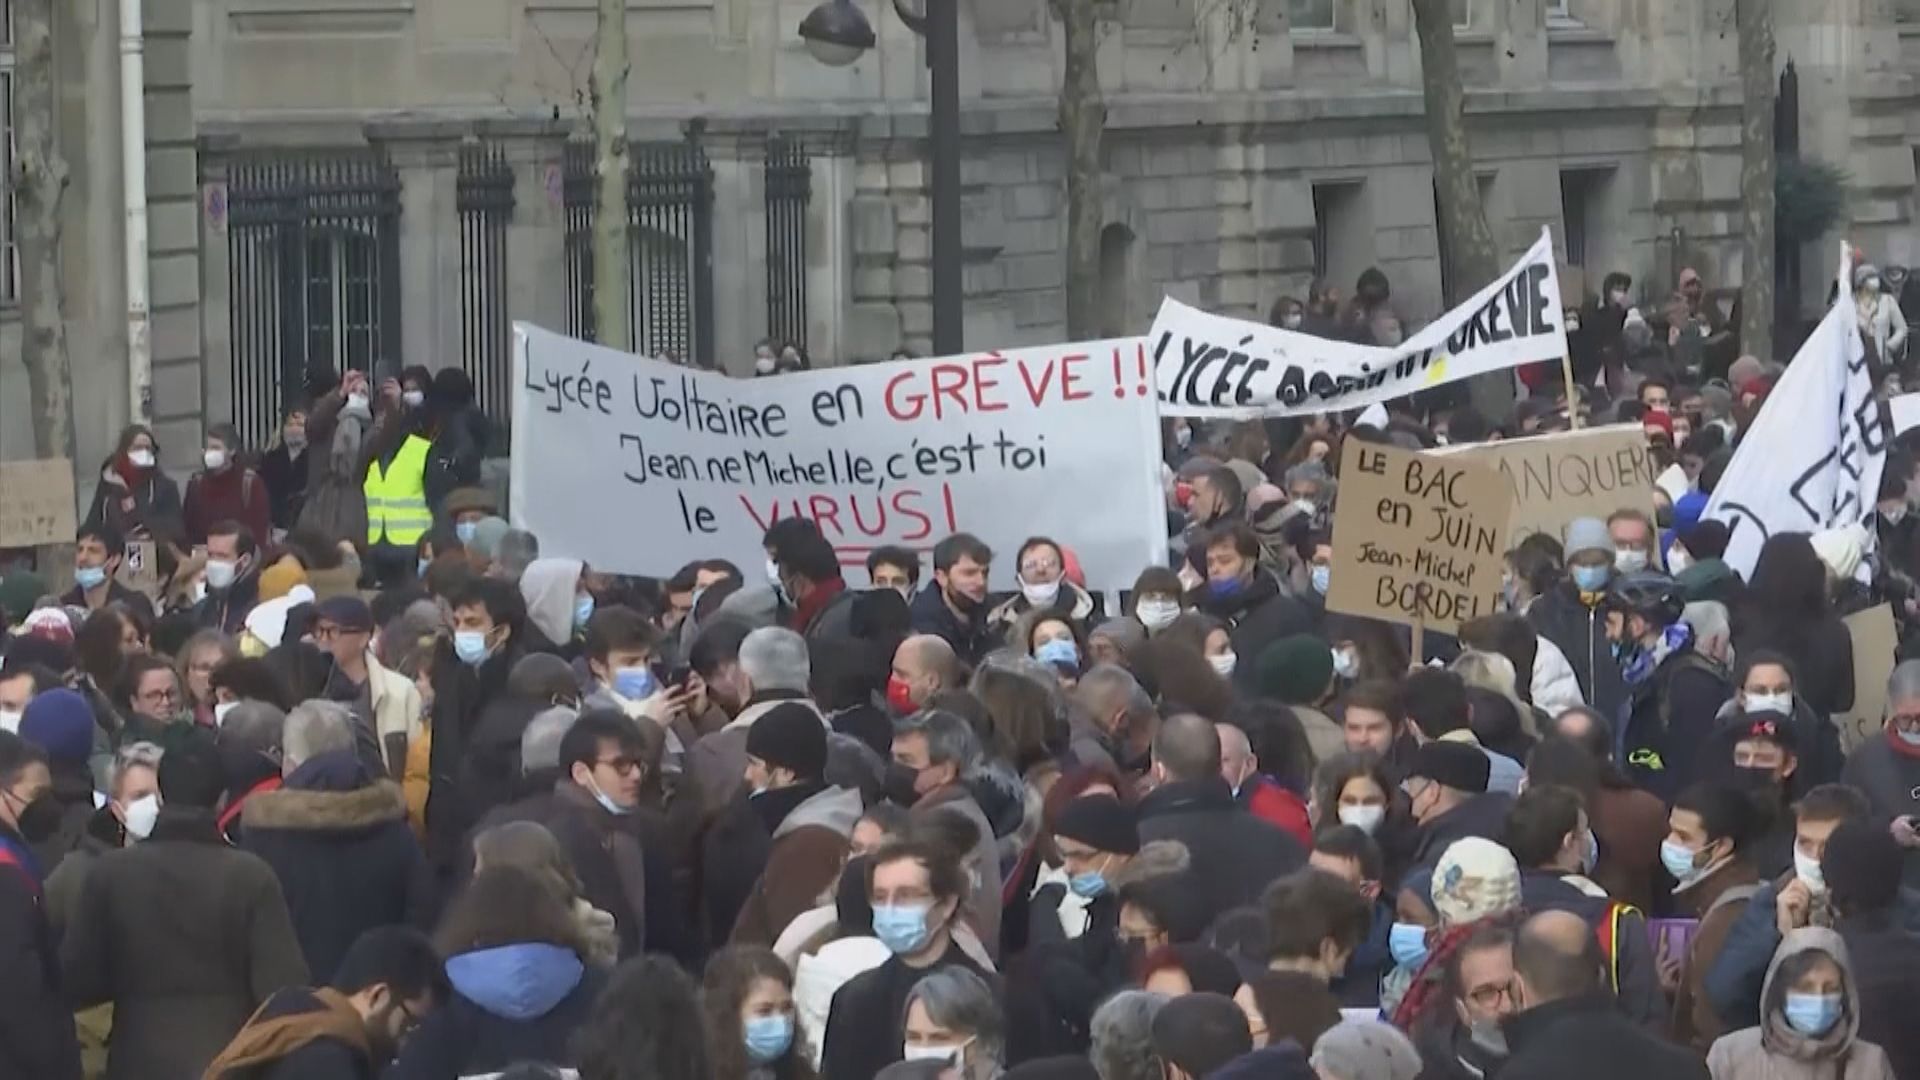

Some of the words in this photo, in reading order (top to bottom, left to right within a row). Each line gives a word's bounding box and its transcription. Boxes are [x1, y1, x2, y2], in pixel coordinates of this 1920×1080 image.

[525, 335, 612, 414] Lycée
[811, 383, 864, 427] en
[884, 349, 1094, 422] GRÈVE
[993, 428, 1047, 471] toi
[1357, 448, 1387, 476] LE
[1404, 458, 1469, 509] BAC
[677, 487, 719, 533] le
[1376, 497, 1413, 529] en
[1356, 541, 1476, 588] Jean-Michel
